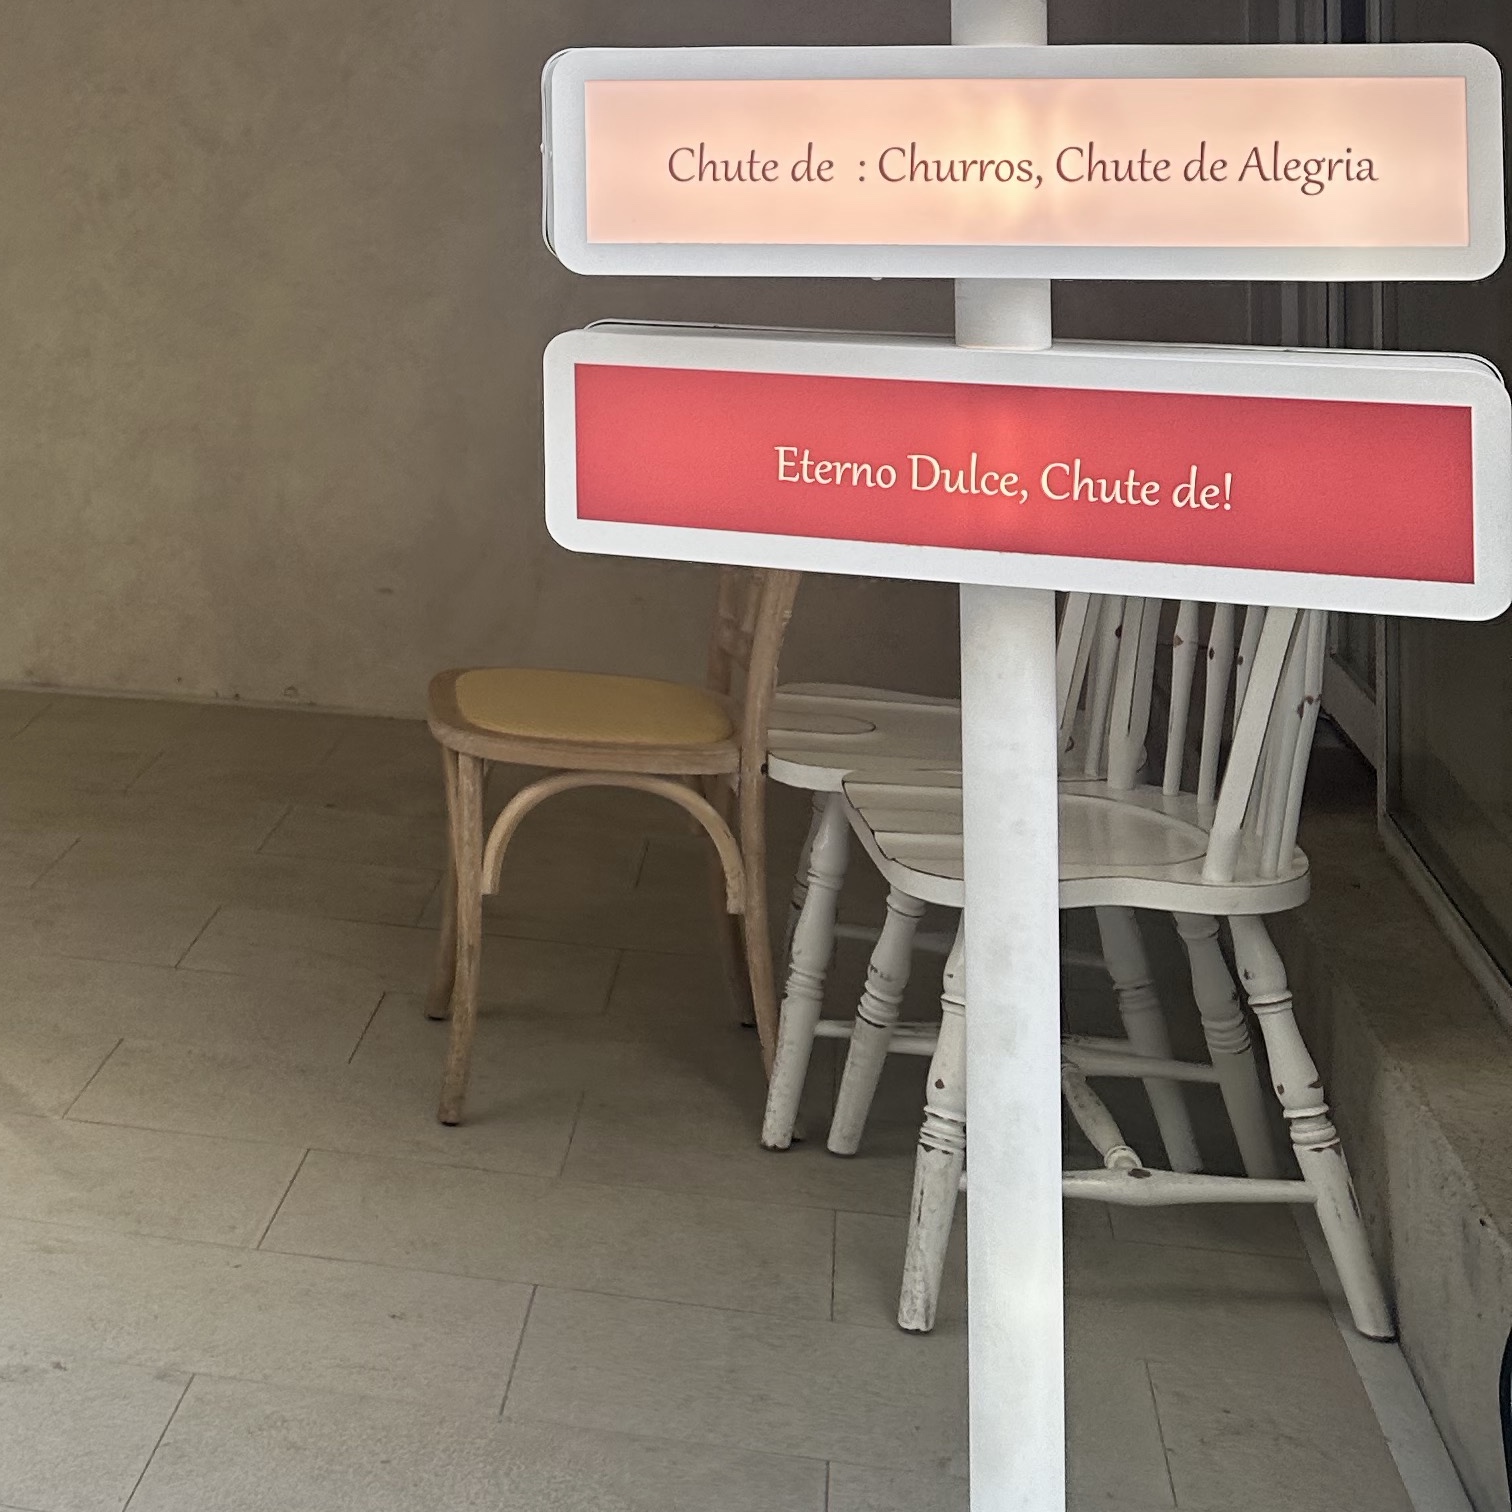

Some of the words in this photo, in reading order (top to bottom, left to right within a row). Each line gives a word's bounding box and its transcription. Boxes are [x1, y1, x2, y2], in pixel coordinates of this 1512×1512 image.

[667, 141, 780, 182] Chute
[790, 141, 835, 182] de
[878, 141, 1043, 189] Churros,
[1055, 140, 1172, 182] Chute
[1183, 140, 1228, 182] de
[1237, 140, 1380, 196] Alegria
[774, 445, 897, 489] Eterno
[906, 452, 1029, 505] Dulce,
[1039, 458, 1161, 507] Chute
[1171, 465, 1234, 511] de!
